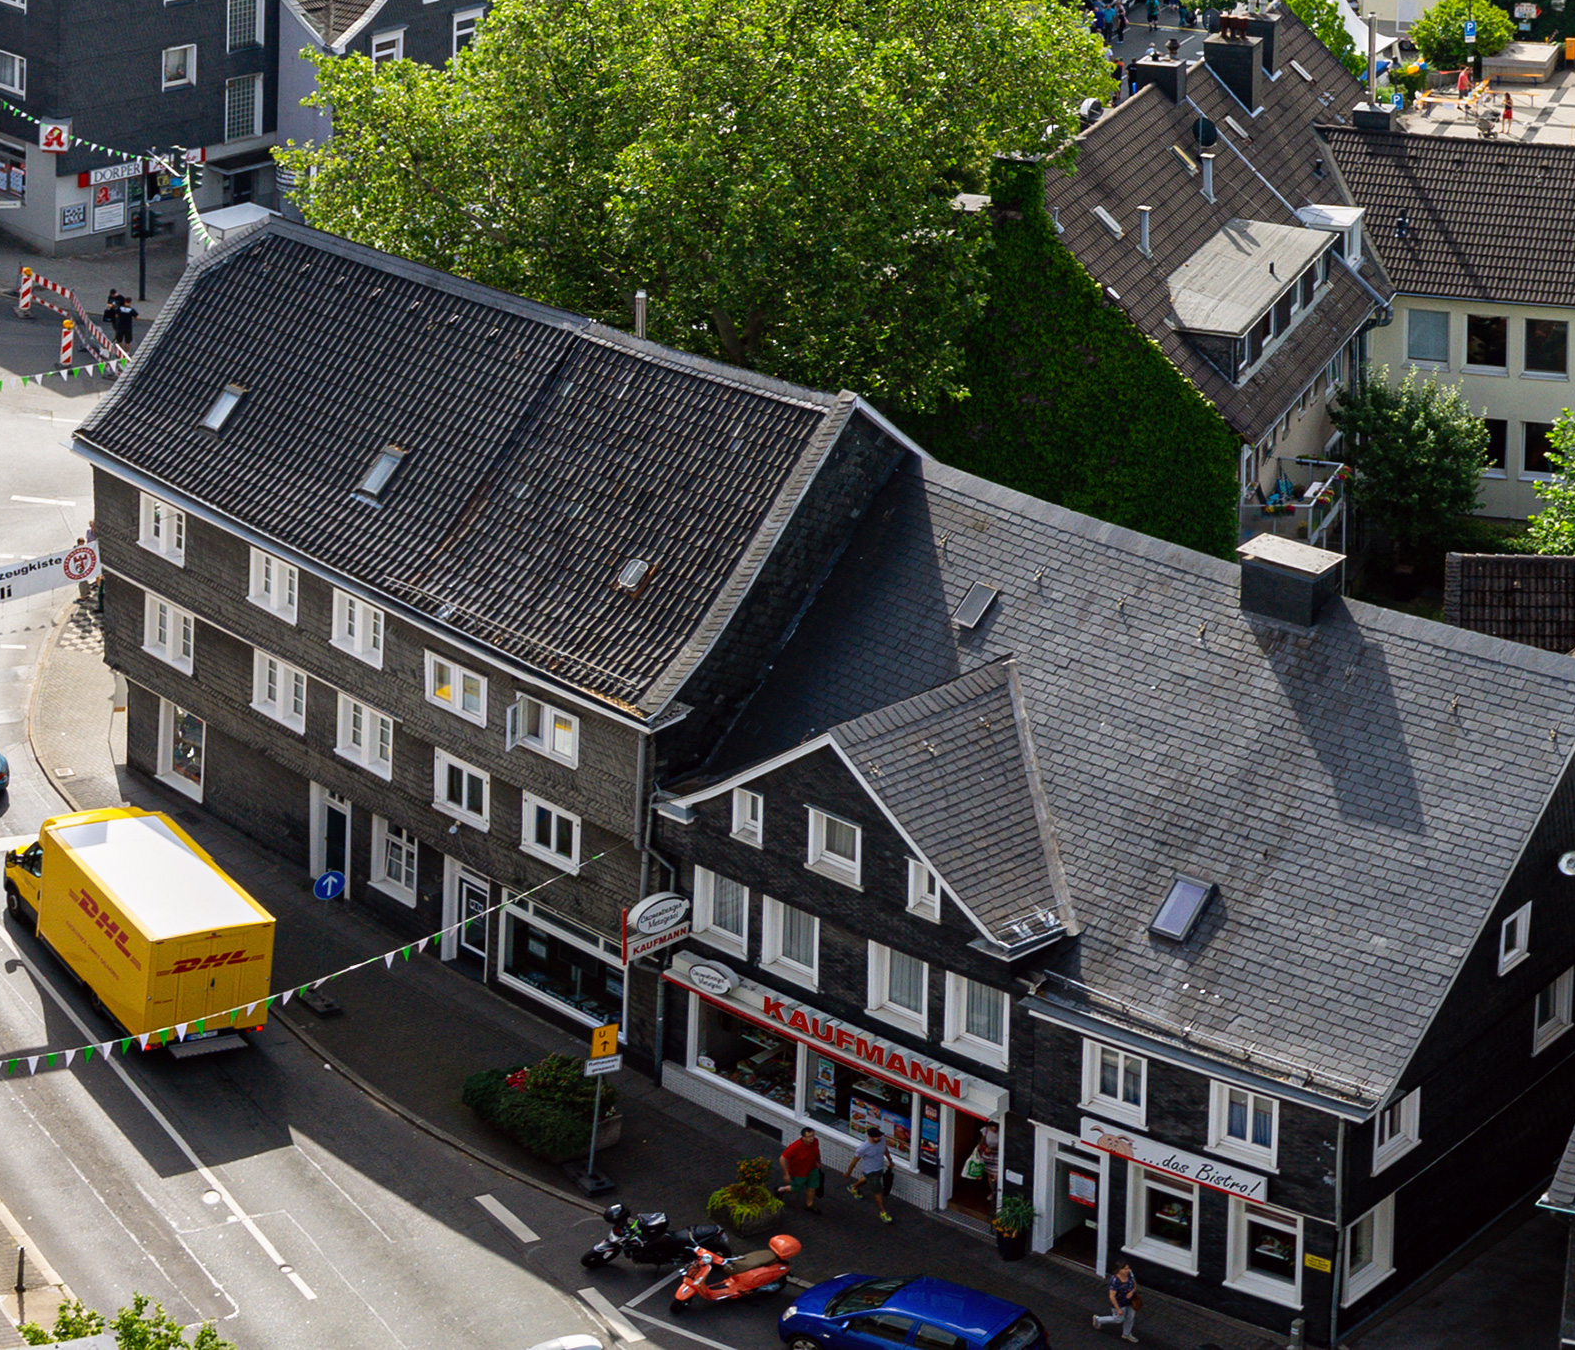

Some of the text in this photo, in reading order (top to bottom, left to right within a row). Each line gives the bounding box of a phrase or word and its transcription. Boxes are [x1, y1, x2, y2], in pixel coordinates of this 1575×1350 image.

[1467, 22, 1474, 31] P
[78, 888, 131, 958] DHL
[632, 926, 687, 956] KAUFMANN
[171, 950, 250, 975] DHL
[598, 1030, 606, 1038] U
[762, 995, 961, 1099] KAUFMANN
[1194, 1163, 1261, 1196] Bistro!
